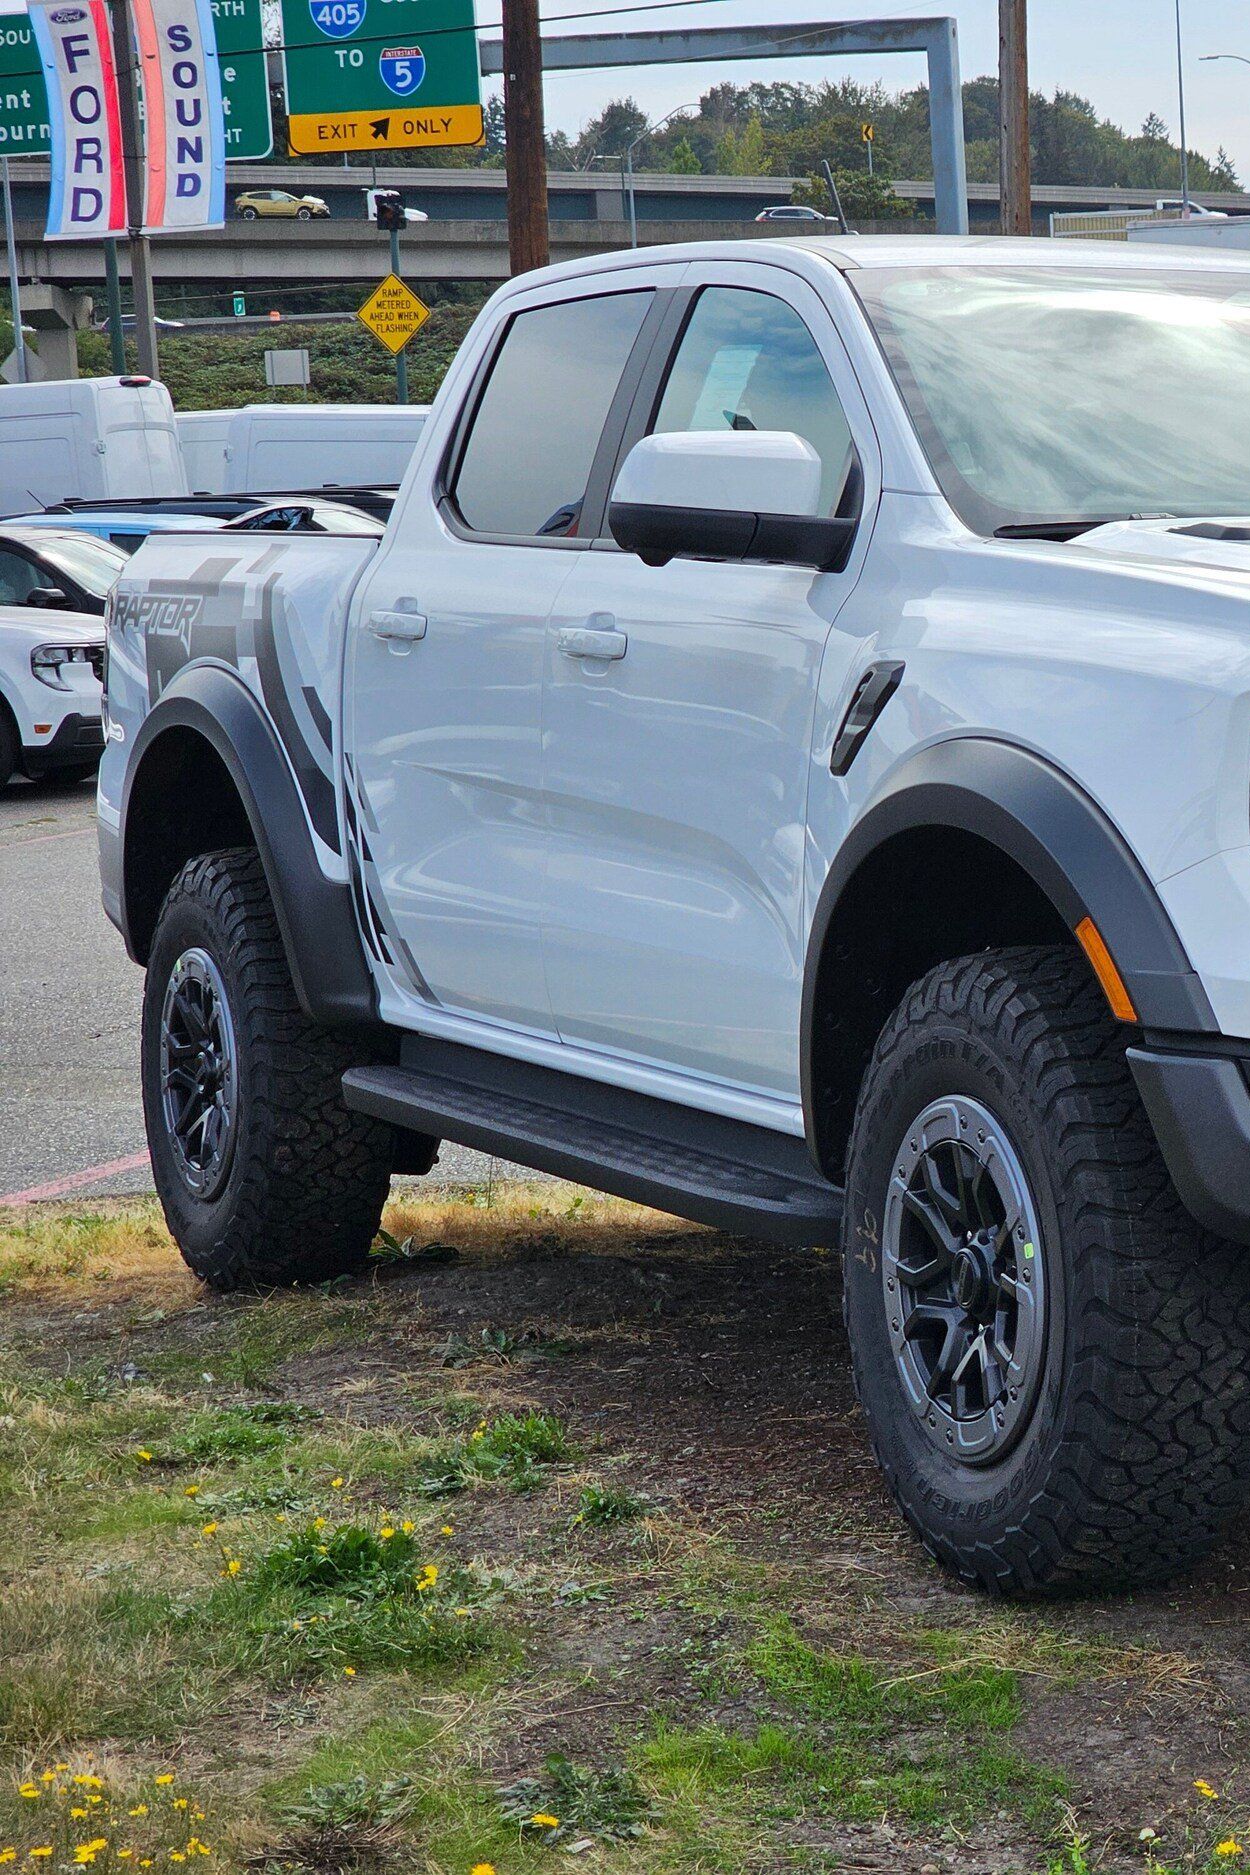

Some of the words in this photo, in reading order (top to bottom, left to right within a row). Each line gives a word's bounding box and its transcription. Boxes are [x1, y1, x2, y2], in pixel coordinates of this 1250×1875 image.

[317, 4, 360, 26] 405
[334, 49, 364, 68] TO
[384, 50, 418, 58] INTERSTATE
[395, 61, 413, 88] 5
[167, 25, 204, 198] SOUND
[61, 33, 104, 222] FORD
[318, 124, 358, 140] EXIT
[403, 118, 452, 135] ONLY
[382, 288, 404, 298] RAMP
[376, 300, 411, 310] METERED
[370, 311, 395, 321] AHEAD
[397, 311, 420, 321] WHEN
[376, 323, 414, 333] FLASHING
[114, 594, 203, 654] RAPTOR
